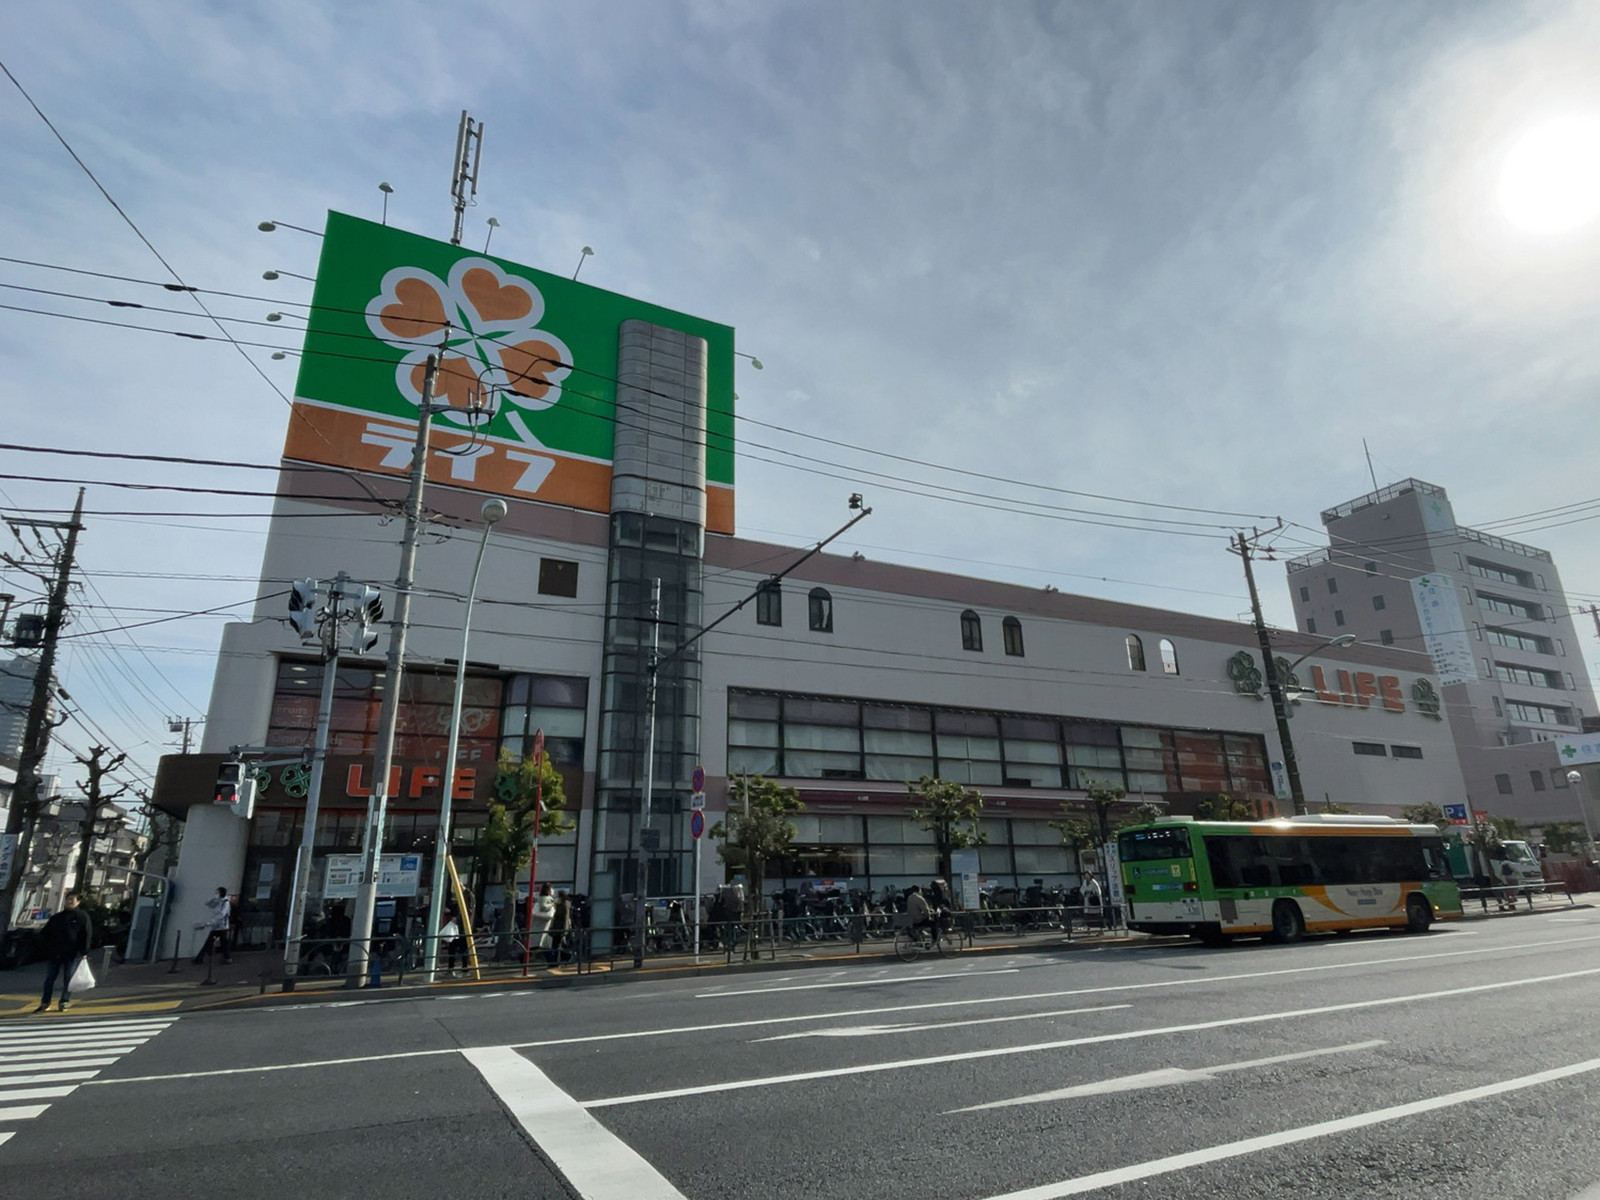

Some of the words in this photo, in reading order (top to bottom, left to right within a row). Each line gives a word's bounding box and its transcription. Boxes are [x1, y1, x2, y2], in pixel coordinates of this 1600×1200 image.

[361, 422, 556, 493] ライフ
[1311, 664, 1405, 713] LIFE
[346, 764, 477, 799] LIFE
[1445, 807, 1455, 818] P
